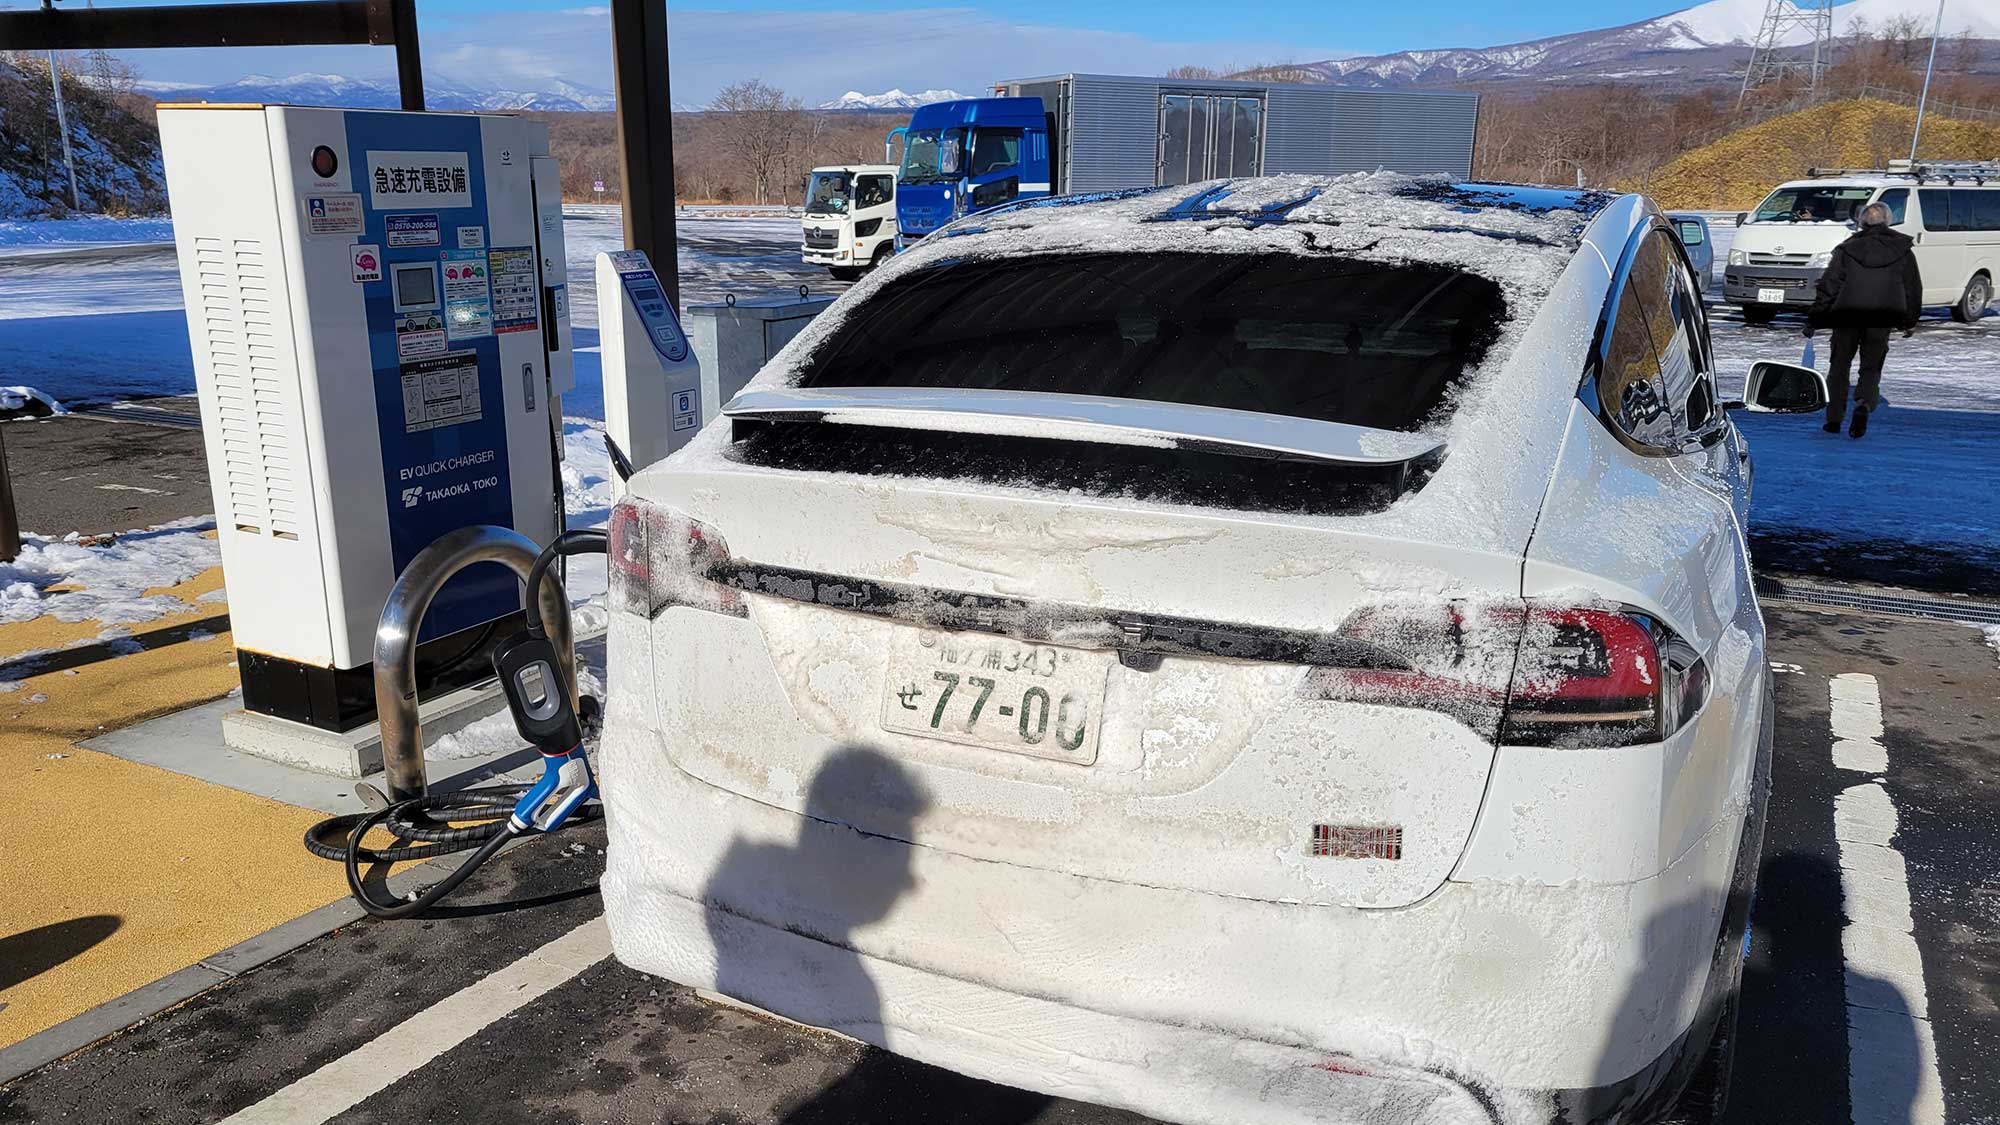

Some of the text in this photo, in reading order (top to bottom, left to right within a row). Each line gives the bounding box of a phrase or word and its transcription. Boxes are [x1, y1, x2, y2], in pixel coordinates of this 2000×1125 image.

[374, 166, 467, 194] 急速充電設備
[400, 450, 494, 480] EV QUICK CHARGER
[426, 476, 498, 502] TAKAOKA TOKO
